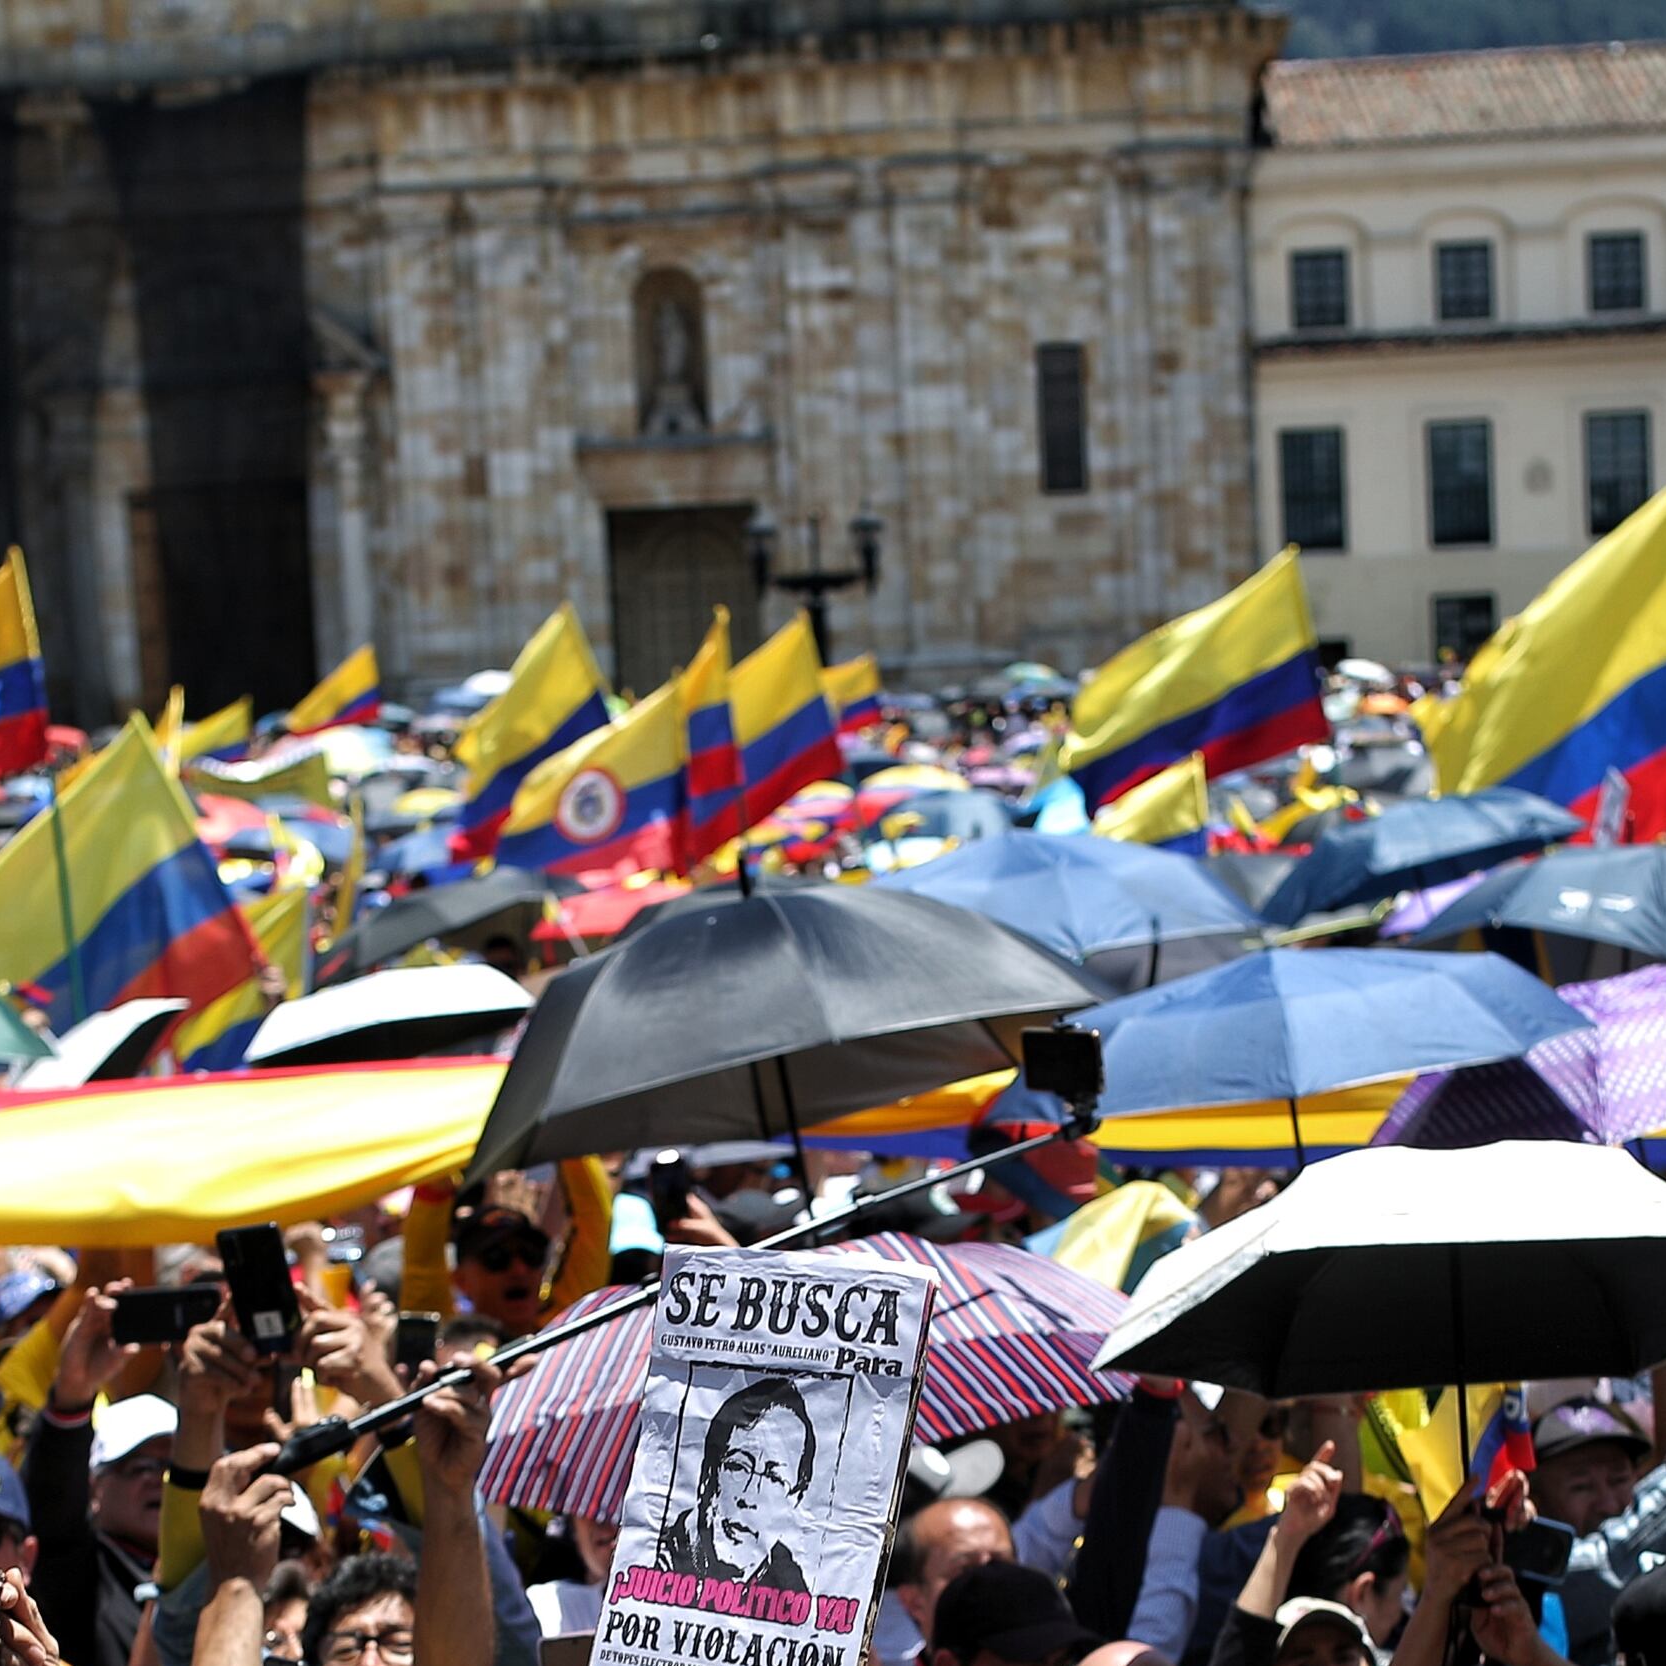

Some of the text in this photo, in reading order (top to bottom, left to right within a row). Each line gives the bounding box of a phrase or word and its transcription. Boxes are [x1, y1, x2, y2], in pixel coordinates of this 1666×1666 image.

[665, 1270, 901, 1347] SE BUSCA
[660, 1334, 703, 1350] GUSTAVO
[736, 1341, 767, 1356] ALIAS
[834, 1347, 903, 1378] Para
[602, 1609, 661, 1652] POR
[815, 1595, 860, 1634] YA!
[600, 1649, 612, 1661] DE
[612, 1650, 640, 1666] TOPES
